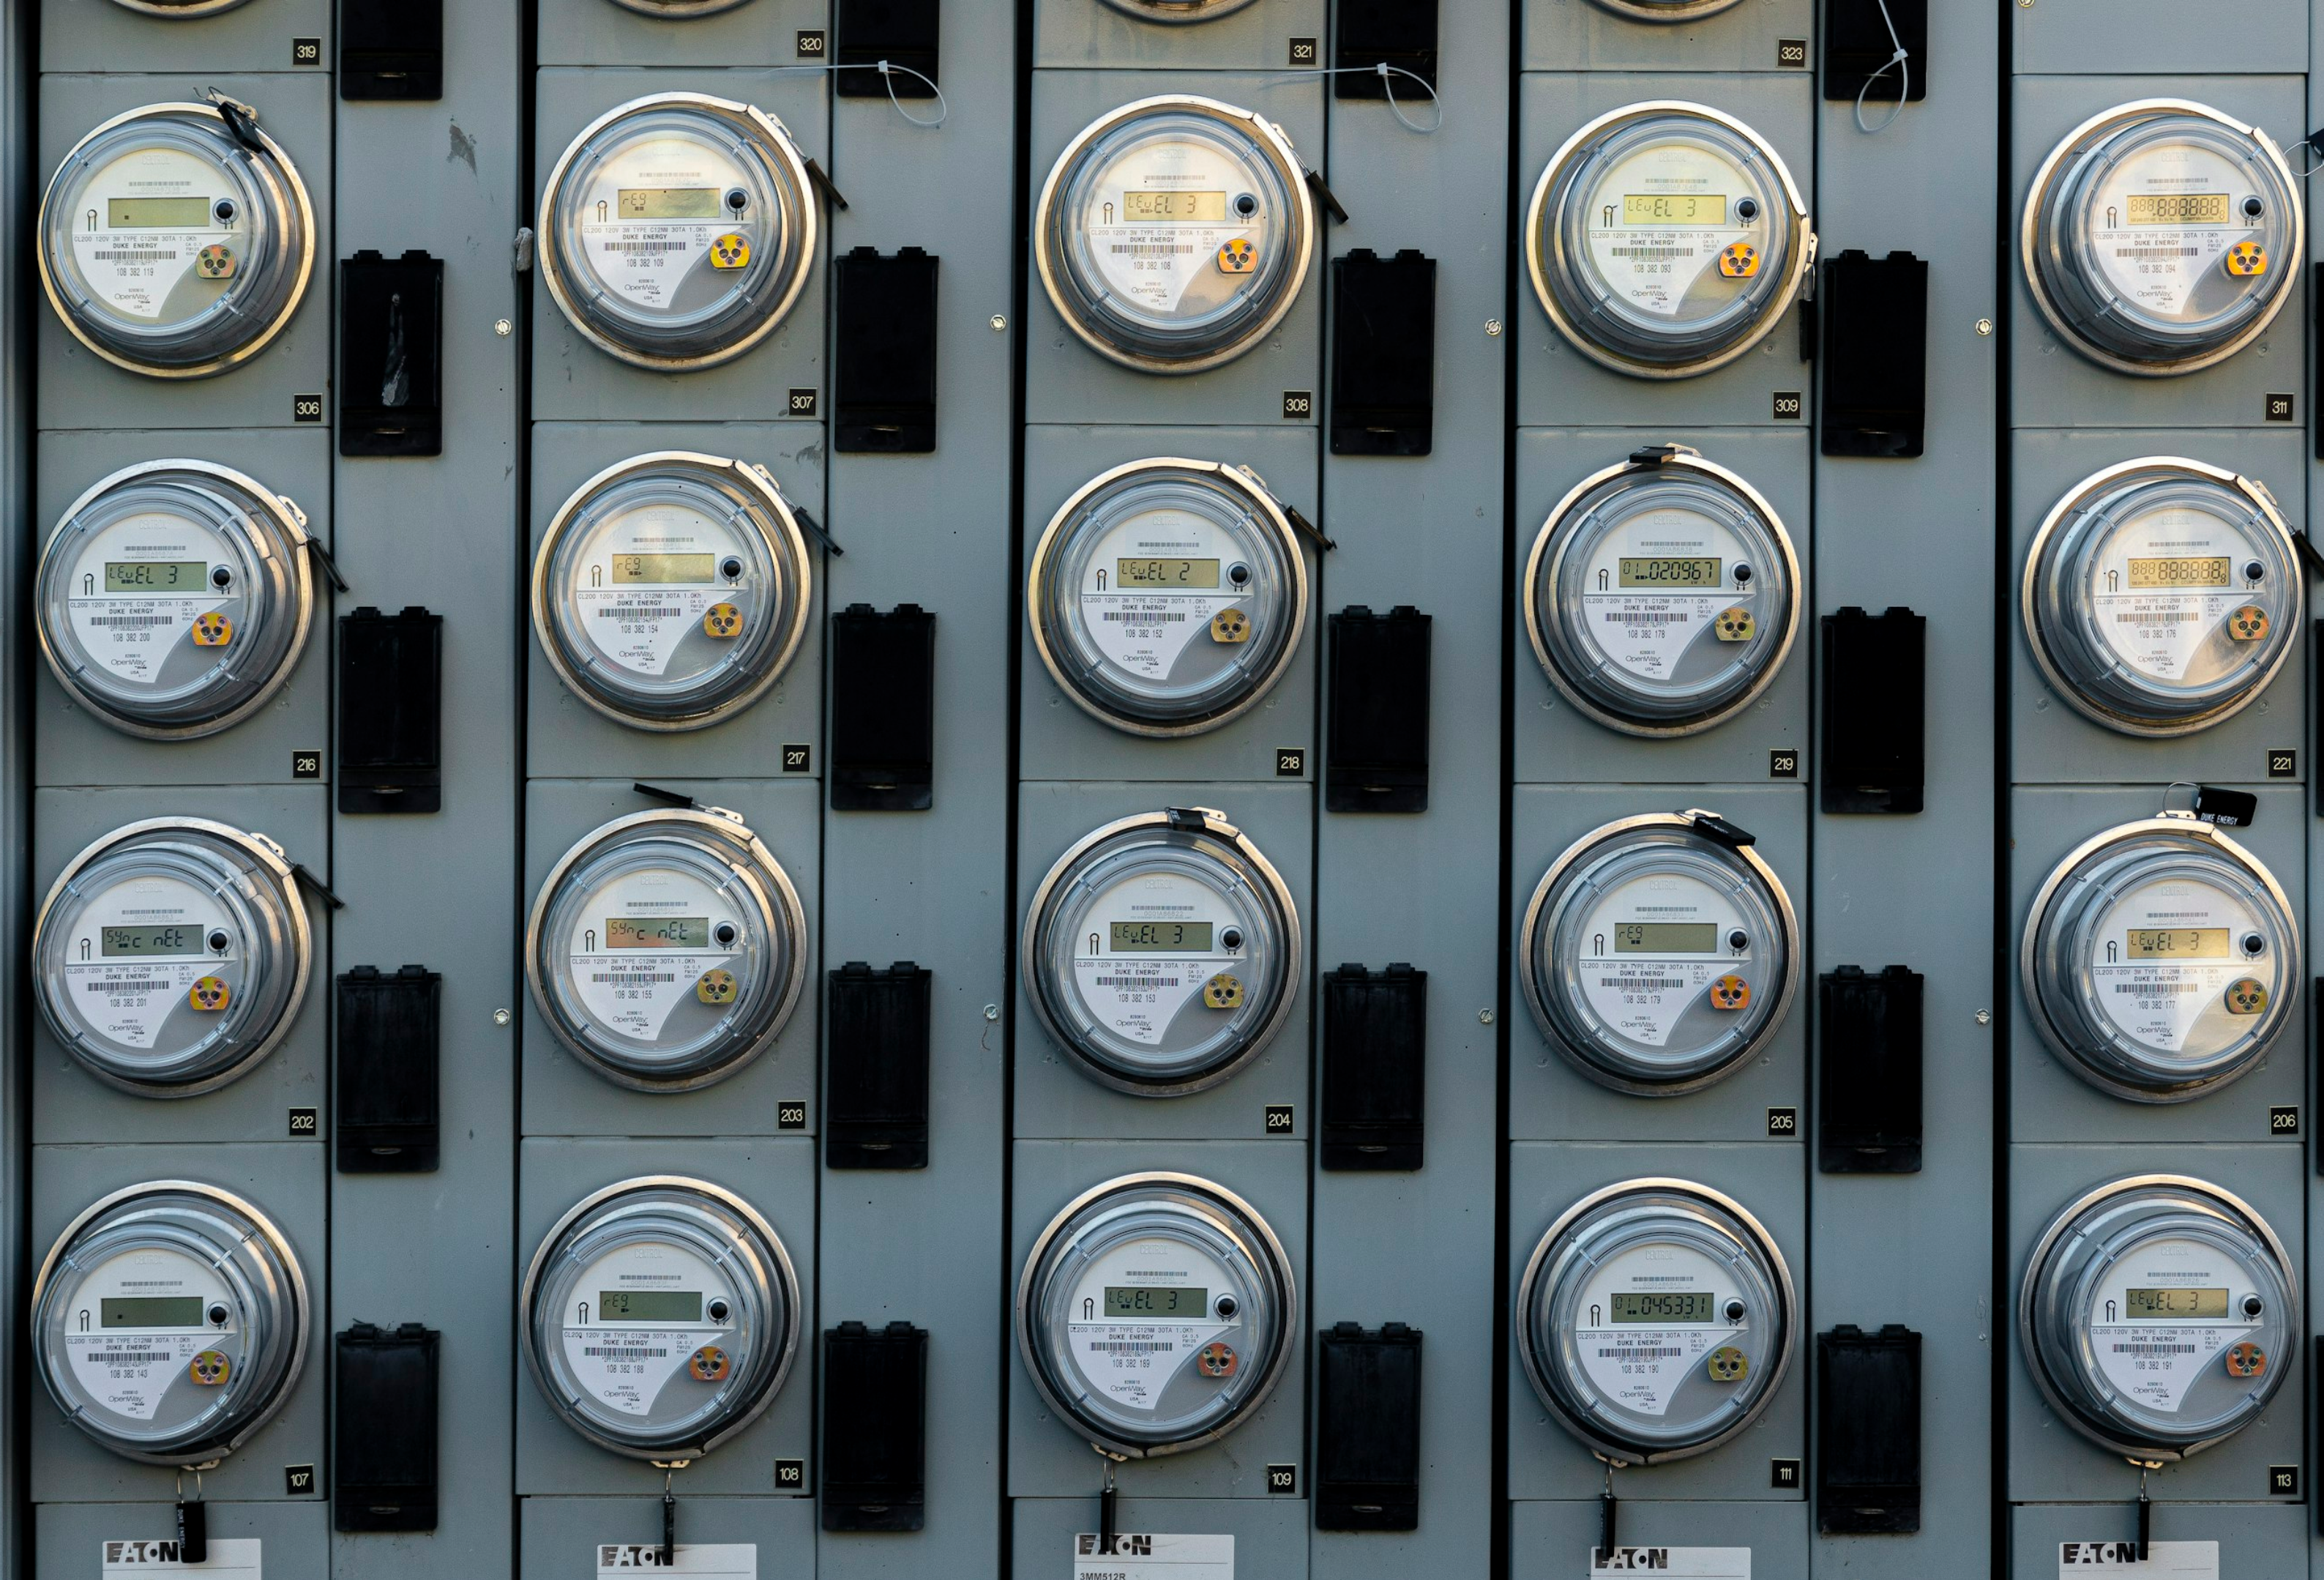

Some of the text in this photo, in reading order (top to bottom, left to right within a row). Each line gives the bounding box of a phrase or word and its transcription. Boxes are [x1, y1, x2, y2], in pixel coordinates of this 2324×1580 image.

[799, 38, 822, 50] 320
[296, 45, 316, 58] 319
[1293, 45, 1312, 58] 321
[1781, 47, 1803, 60] 323
[627, 258, 636, 267] 108
[640, 258, 650, 267] 382
[1147, 261, 1157, 270] 382
[1634, 264, 1644, 273] 108
[1648, 264, 1657, 273] 382
[116, 268, 127, 276] 108
[130, 268, 140, 276] 382
[2139, 265, 2148, 273] 108
[2152, 265, 2162, 273] 382
[296, 402, 319, 414] 306
[791, 395, 814, 409] 307
[1286, 399, 1308, 411] 308
[1776, 400, 1798, 411] 309
[2272, 401, 2287, 413] 311
[168, 565, 177, 584] 3
[1649, 562, 1712, 580] 020967
[621, 625, 631, 633] 108
[635, 625, 644, 633] 382
[1139, 630, 1148, 638] 382
[1628, 630, 1637, 638] 108
[1641, 630, 1651, 638] 382
[2153, 630, 2163, 638] 382
[113, 633, 123, 642] 108
[127, 633, 136, 642] 382
[787, 752, 806, 764] 217
[1280, 756, 1299, 769] 218
[1774, 757, 1793, 770] 219
[2273, 756, 2292, 769] 221
[297, 759, 316, 771] 216
[2200, 813, 2238, 825] DUKE ENERGY
[1174, 925, 1182, 944] 3
[628, 991, 638, 999] 382
[1118, 994, 1128, 1002] 108
[1132, 994, 1142, 1002] 382
[1624, 995, 1633, 1004] 108
[1637, 995, 1647, 1004] 382
[110, 999, 120, 1007] 108
[124, 999, 133, 1007] 382
[2139, 1001, 2148, 1010] 108
[2152, 1001, 2162, 1010] 382
[780, 1109, 803, 1121] 203
[1268, 1114, 1290, 1126] 204
[2273, 1114, 2296, 1127] 206
[291, 1116, 314, 1128] 202
[1771, 1116, 1793, 1128] 205
[1641, 1296, 1705, 1315] 045331
[2190, 1291, 2199, 1311] 3
[607, 1365, 616, 1374] 108
[620, 1365, 630, 1374] 382
[1113, 1360, 1122, 1368] 108
[1126, 1360, 1136, 1368] 382
[1635, 1365, 1645, 1374] 382
[2149, 1361, 2159, 1370] 382
[110, 1370, 120, 1379] 108
[124, 1370, 133, 1379] 382
[780, 1467, 799, 1480] 108
[1272, 1473, 1292, 1485] 109
[1779, 1467, 1792, 1480] 111
[291, 1474, 309, 1486] 107
[2276, 1475, 2292, 1486] 113
[106, 1542, 179, 1563] EATON
[2063, 1543, 2136, 1564] EATON
